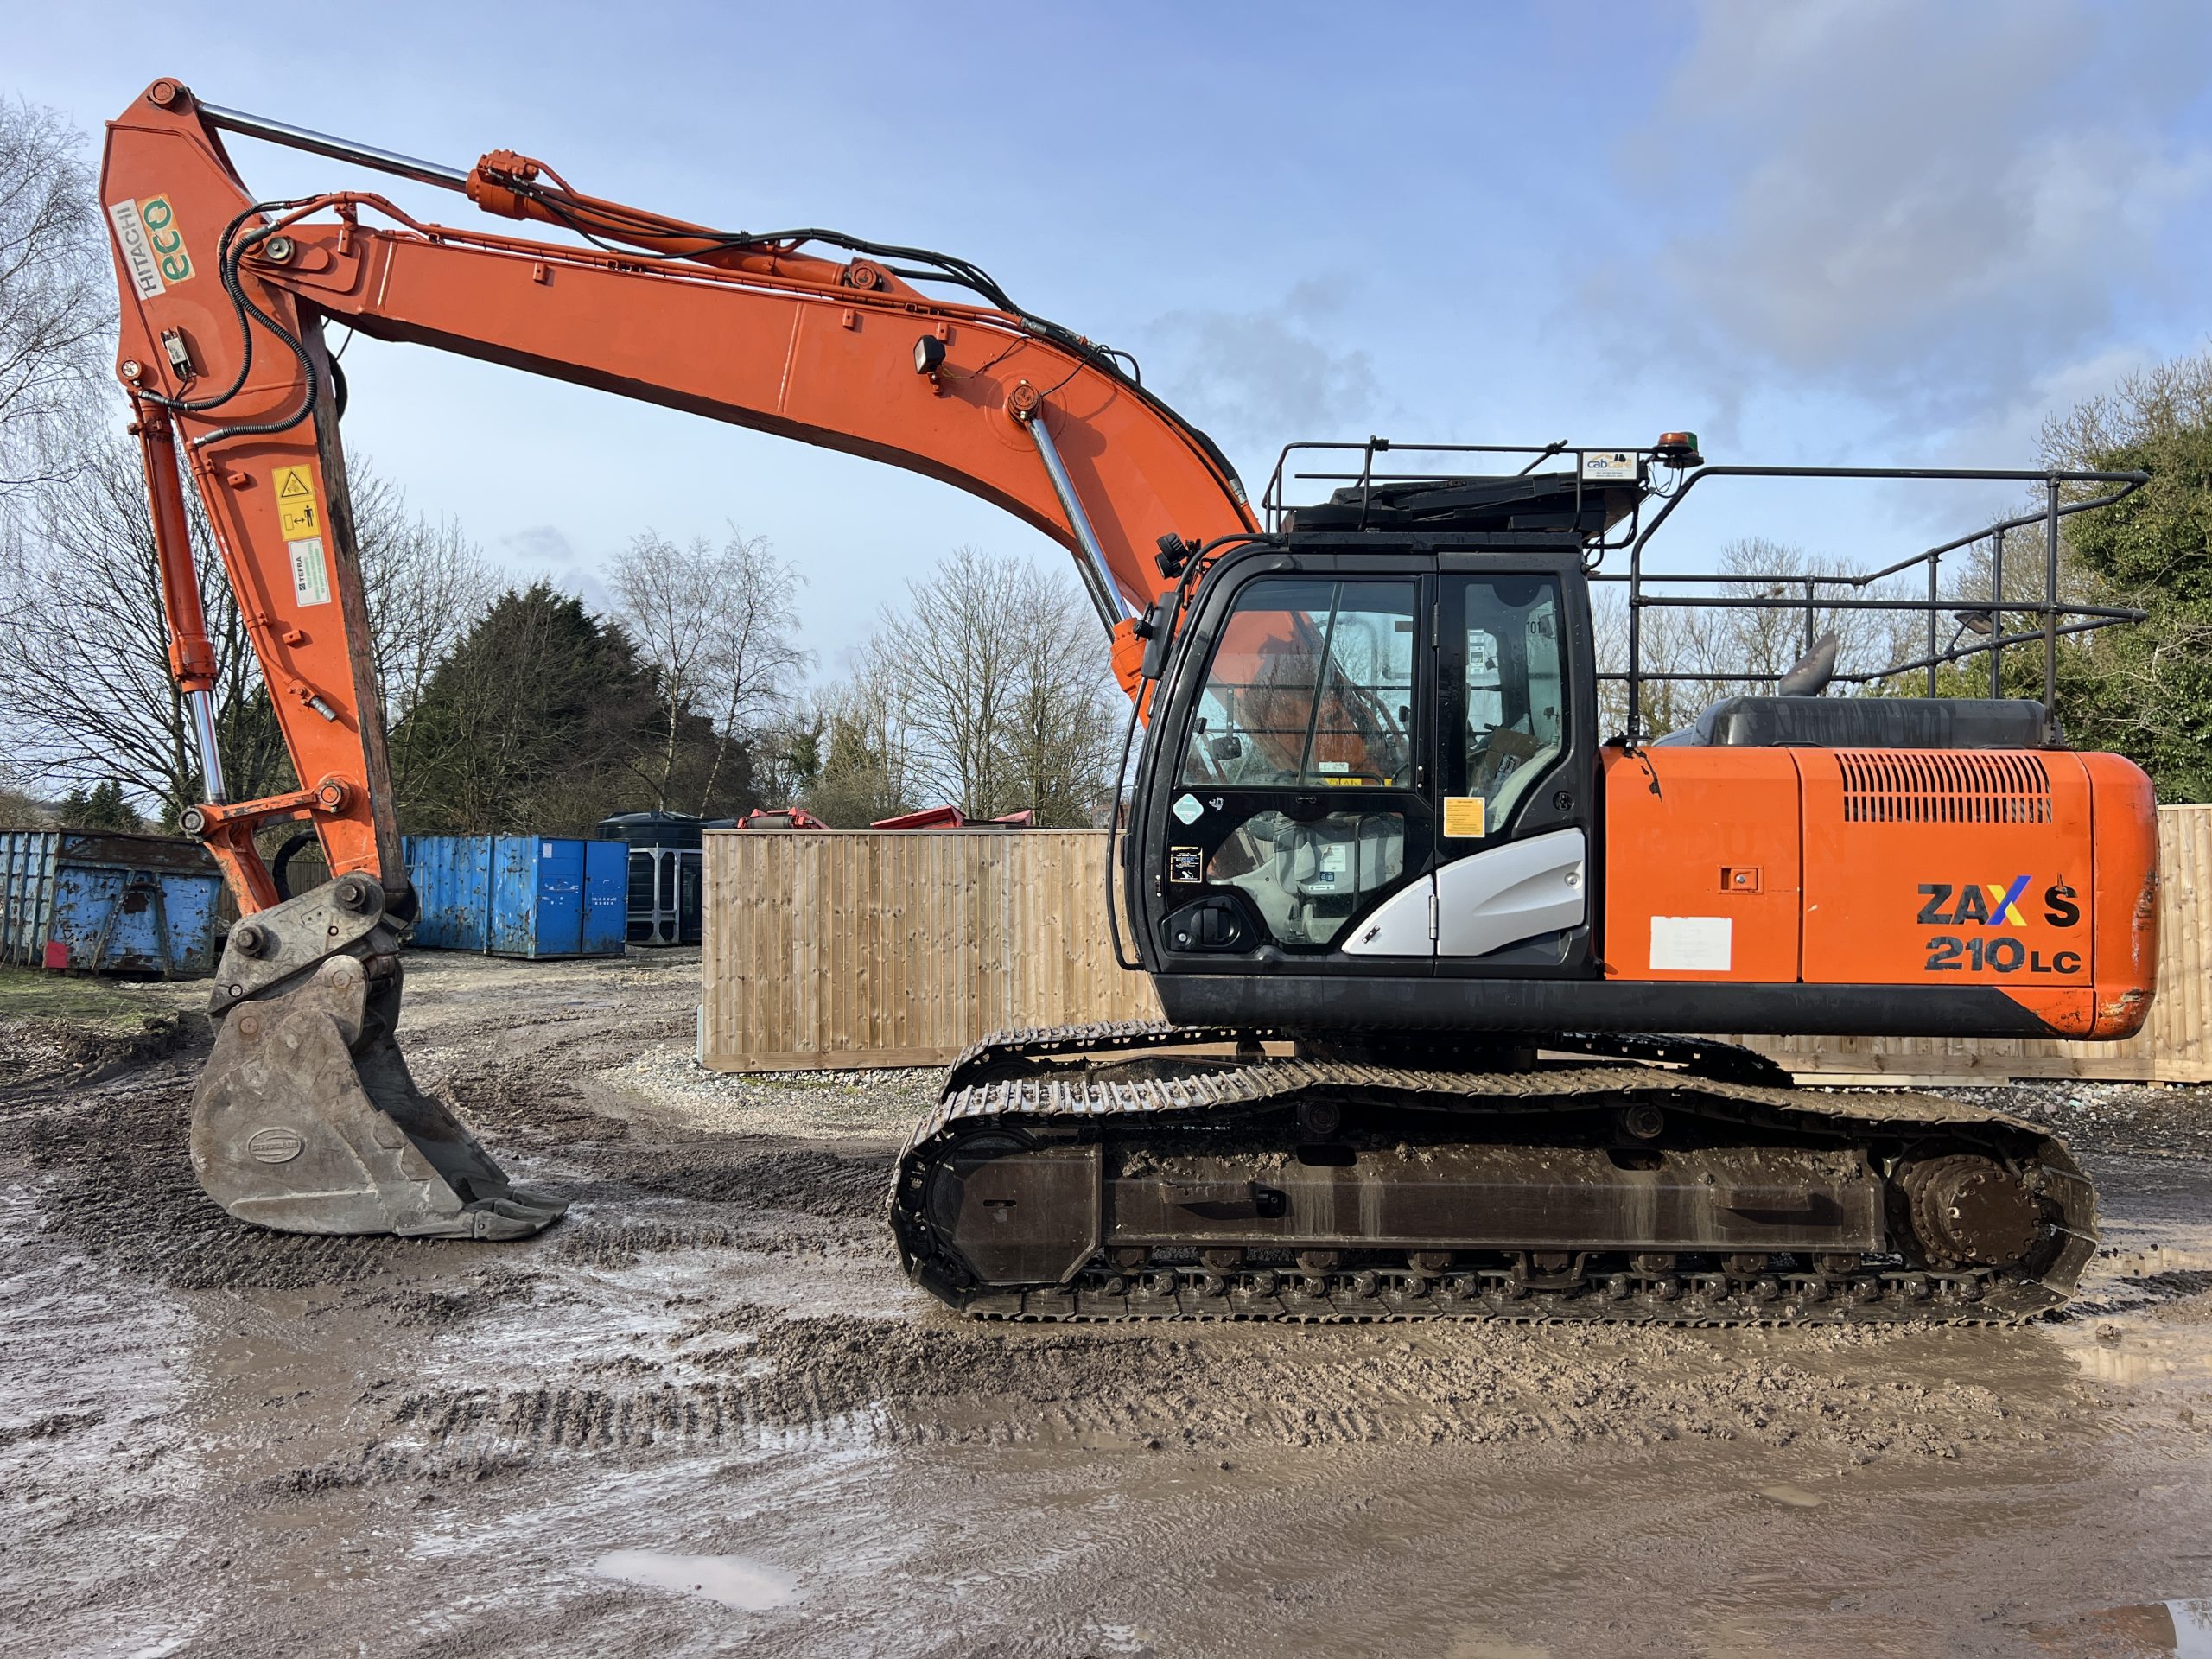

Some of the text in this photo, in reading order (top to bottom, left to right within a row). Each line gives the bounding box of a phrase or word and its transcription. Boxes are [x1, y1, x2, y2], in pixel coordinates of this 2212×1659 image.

[117, 207, 157, 292] HITACHI
[296, 556, 304, 582] TEFRA
[1526, 620, 1541, 634] 101
